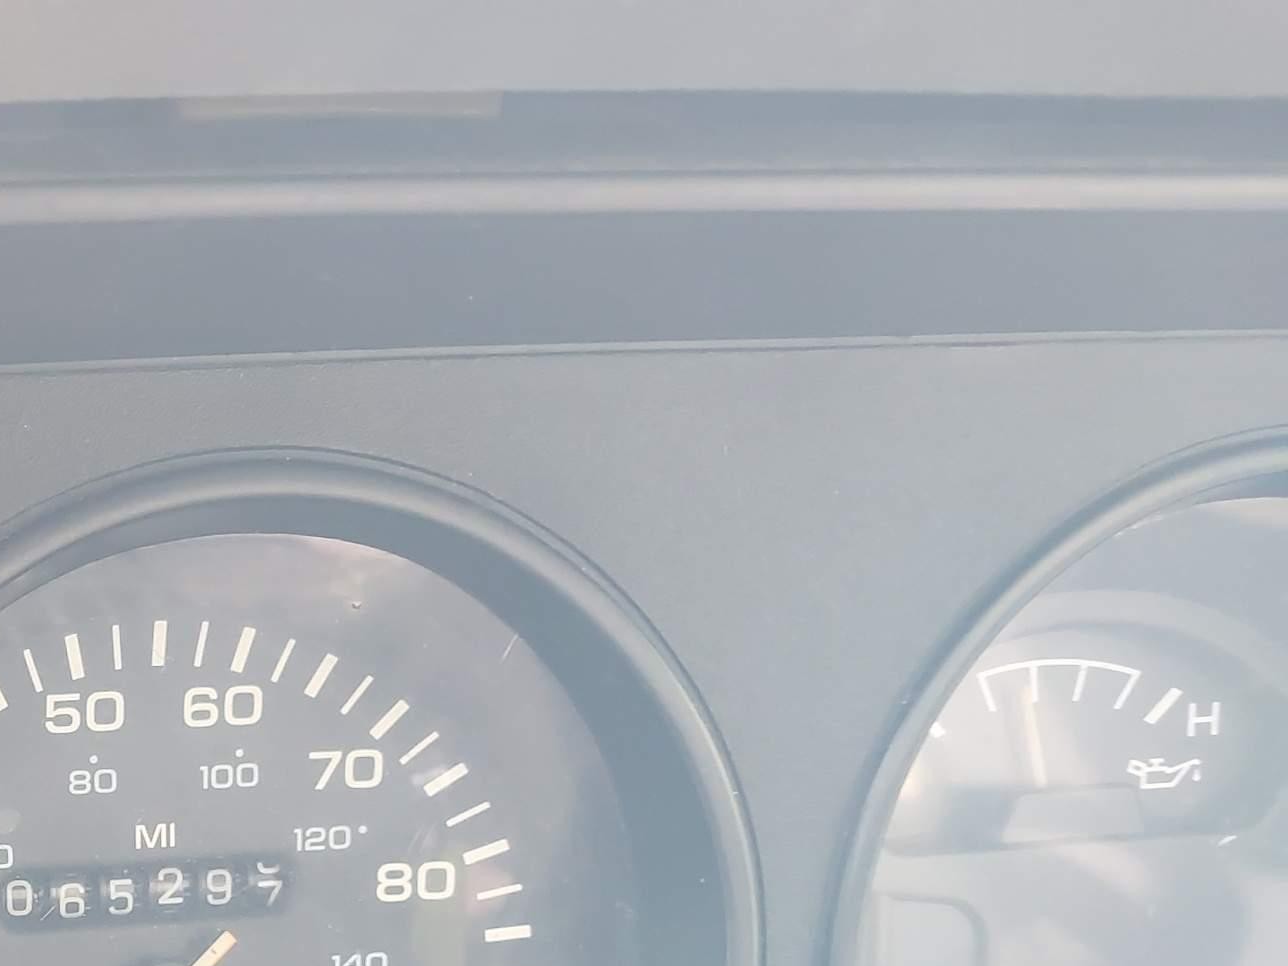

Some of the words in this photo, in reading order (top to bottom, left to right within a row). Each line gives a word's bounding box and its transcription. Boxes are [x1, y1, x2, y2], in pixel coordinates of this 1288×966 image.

[44, 690, 125, 734] 50
[183, 685, 263, 728] 60
[1186, 701, 1220, 736] H
[68, 769, 117, 794] 80
[200, 763, 259, 789] 100
[309, 749, 383, 790] 70
[135, 823, 176, 850] MI
[294, 826, 351, 851] 120
[376, 861, 456, 902] 80
